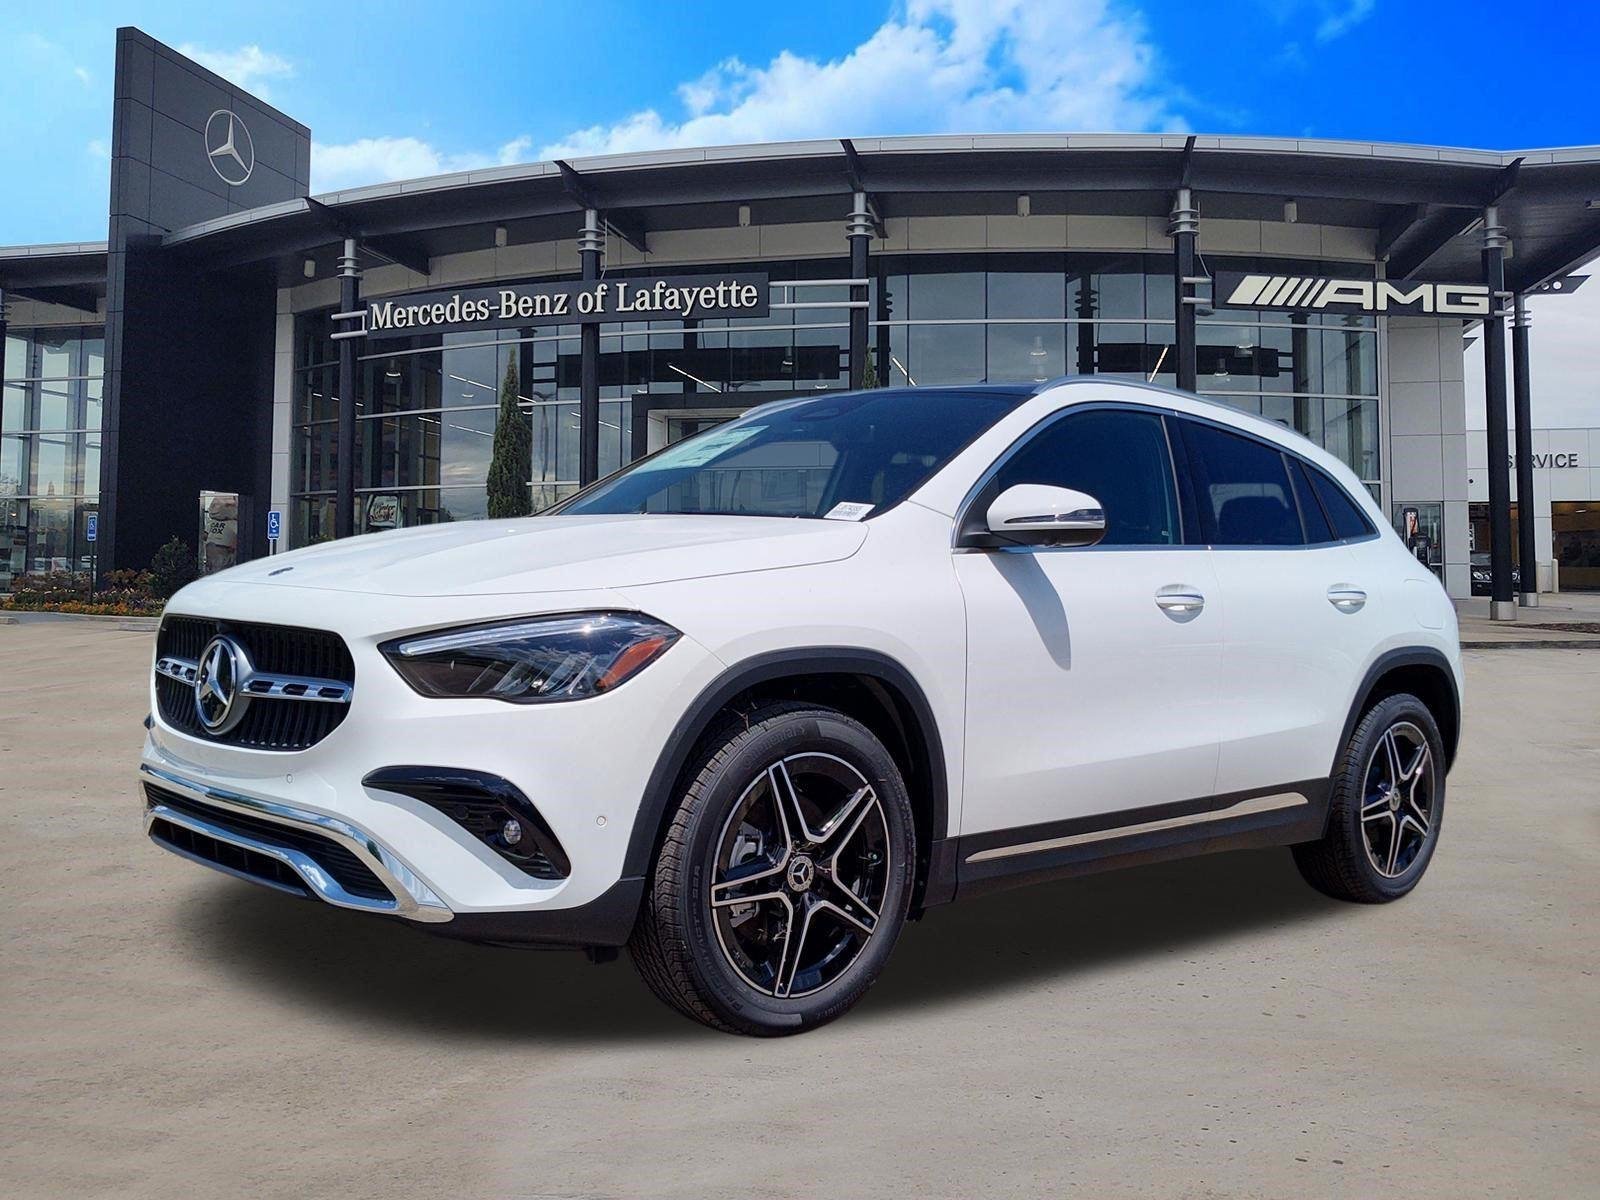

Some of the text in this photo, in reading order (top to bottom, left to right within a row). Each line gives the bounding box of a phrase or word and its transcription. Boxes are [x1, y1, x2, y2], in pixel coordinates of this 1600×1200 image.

[370, 280, 758, 330] Mercedes-Benz of Lafayette
[1312, 279, 1490, 315] AMG
[1507, 453, 1579, 468] SVICE
